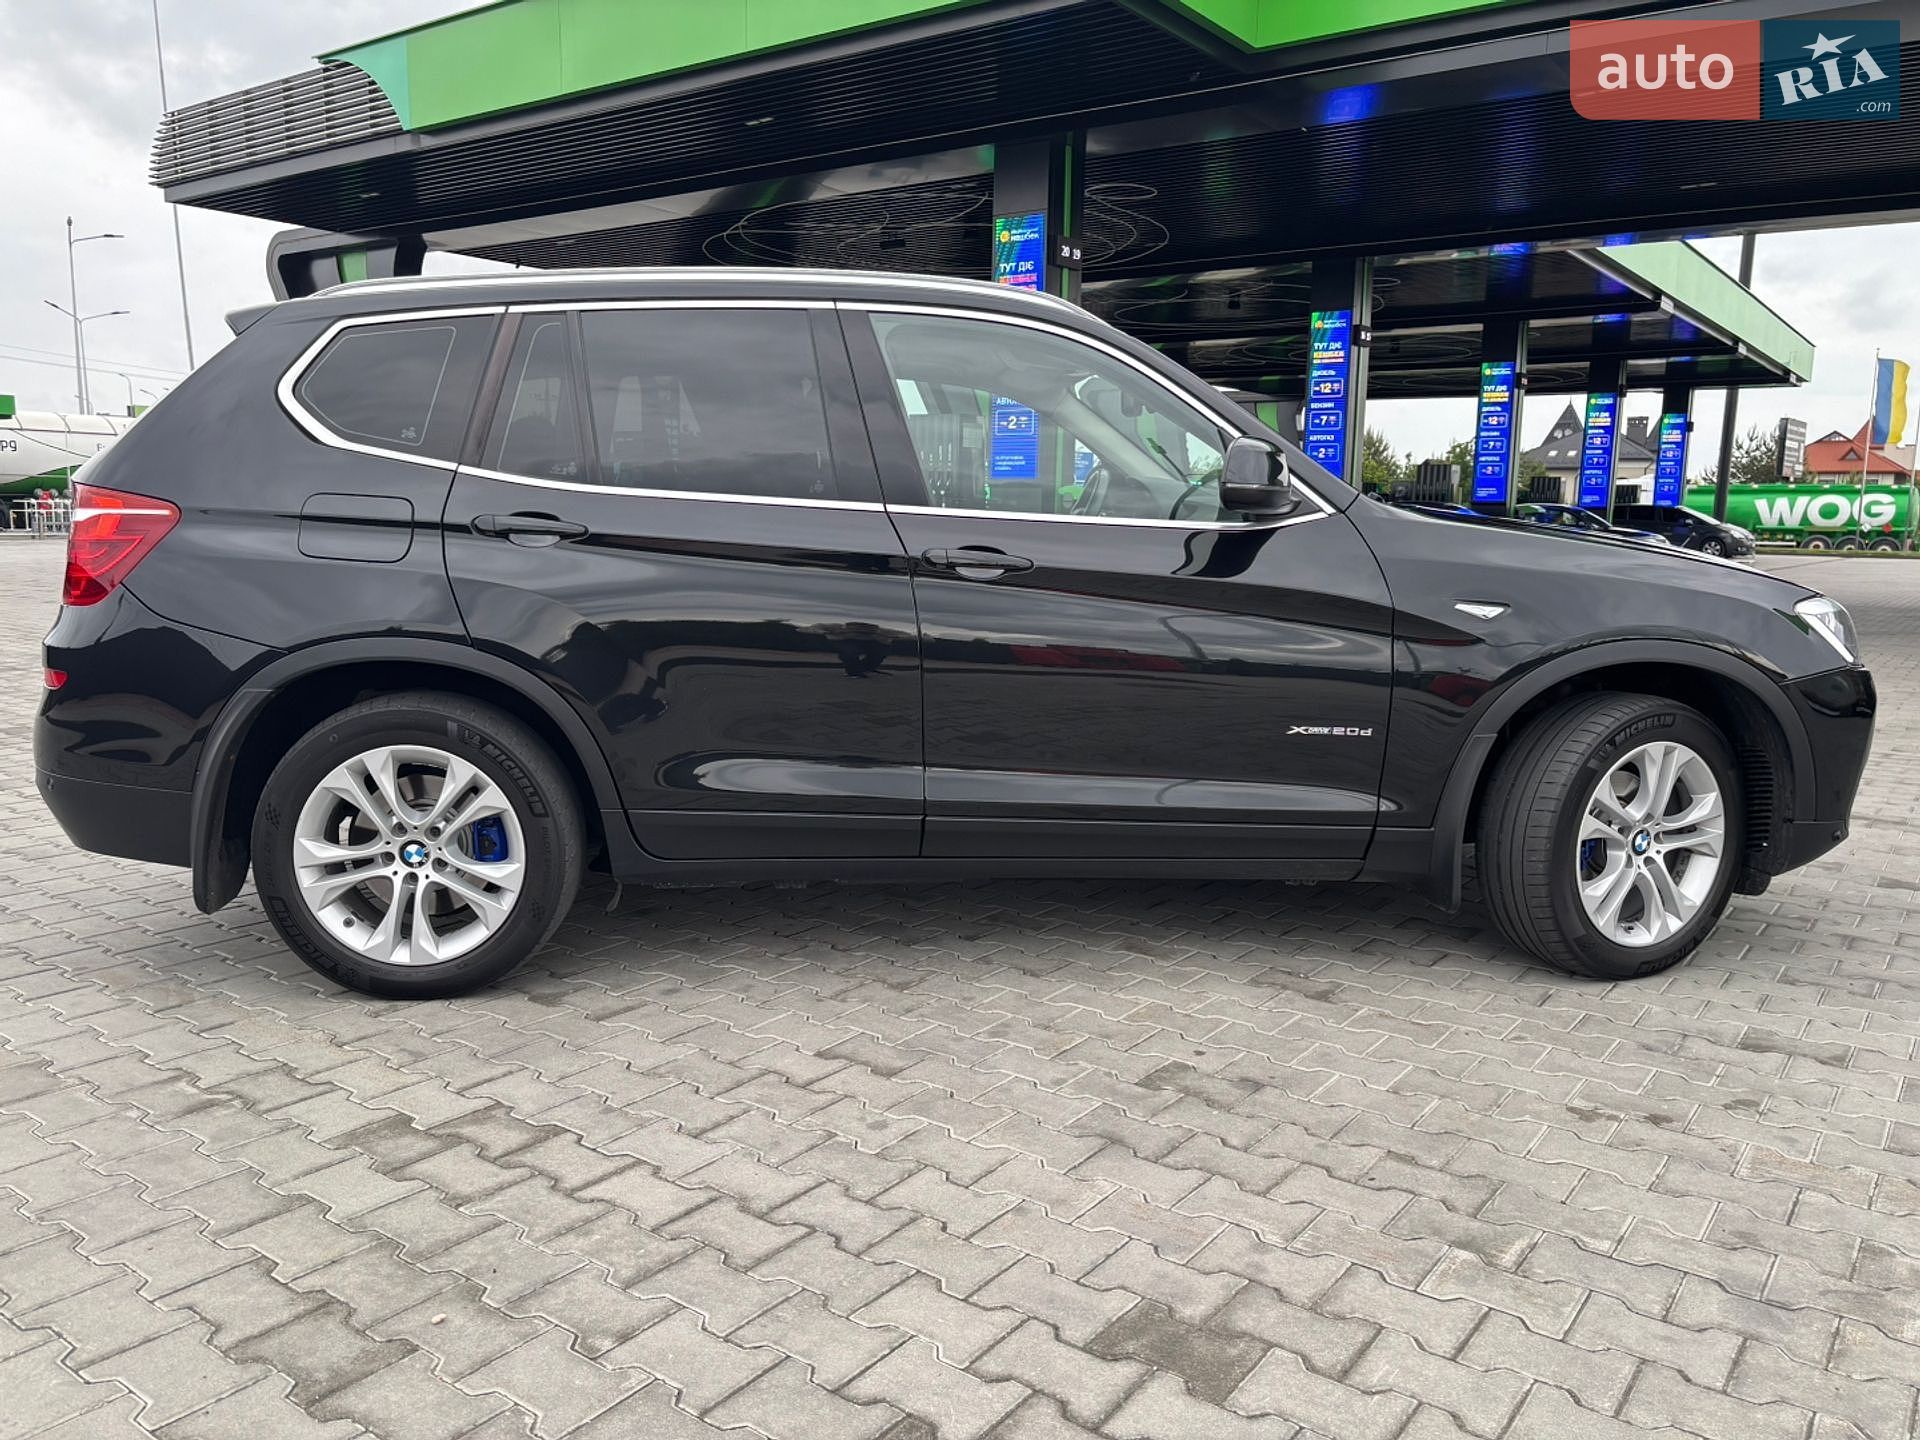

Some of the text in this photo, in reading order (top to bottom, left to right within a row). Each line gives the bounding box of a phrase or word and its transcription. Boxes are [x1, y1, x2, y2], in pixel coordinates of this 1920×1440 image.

[1061, 245, 1070, 257] 20
[1000, 261, 1034, 272] ТУТ ДІЄ
[1754, 493, 1897, 528] WOG
